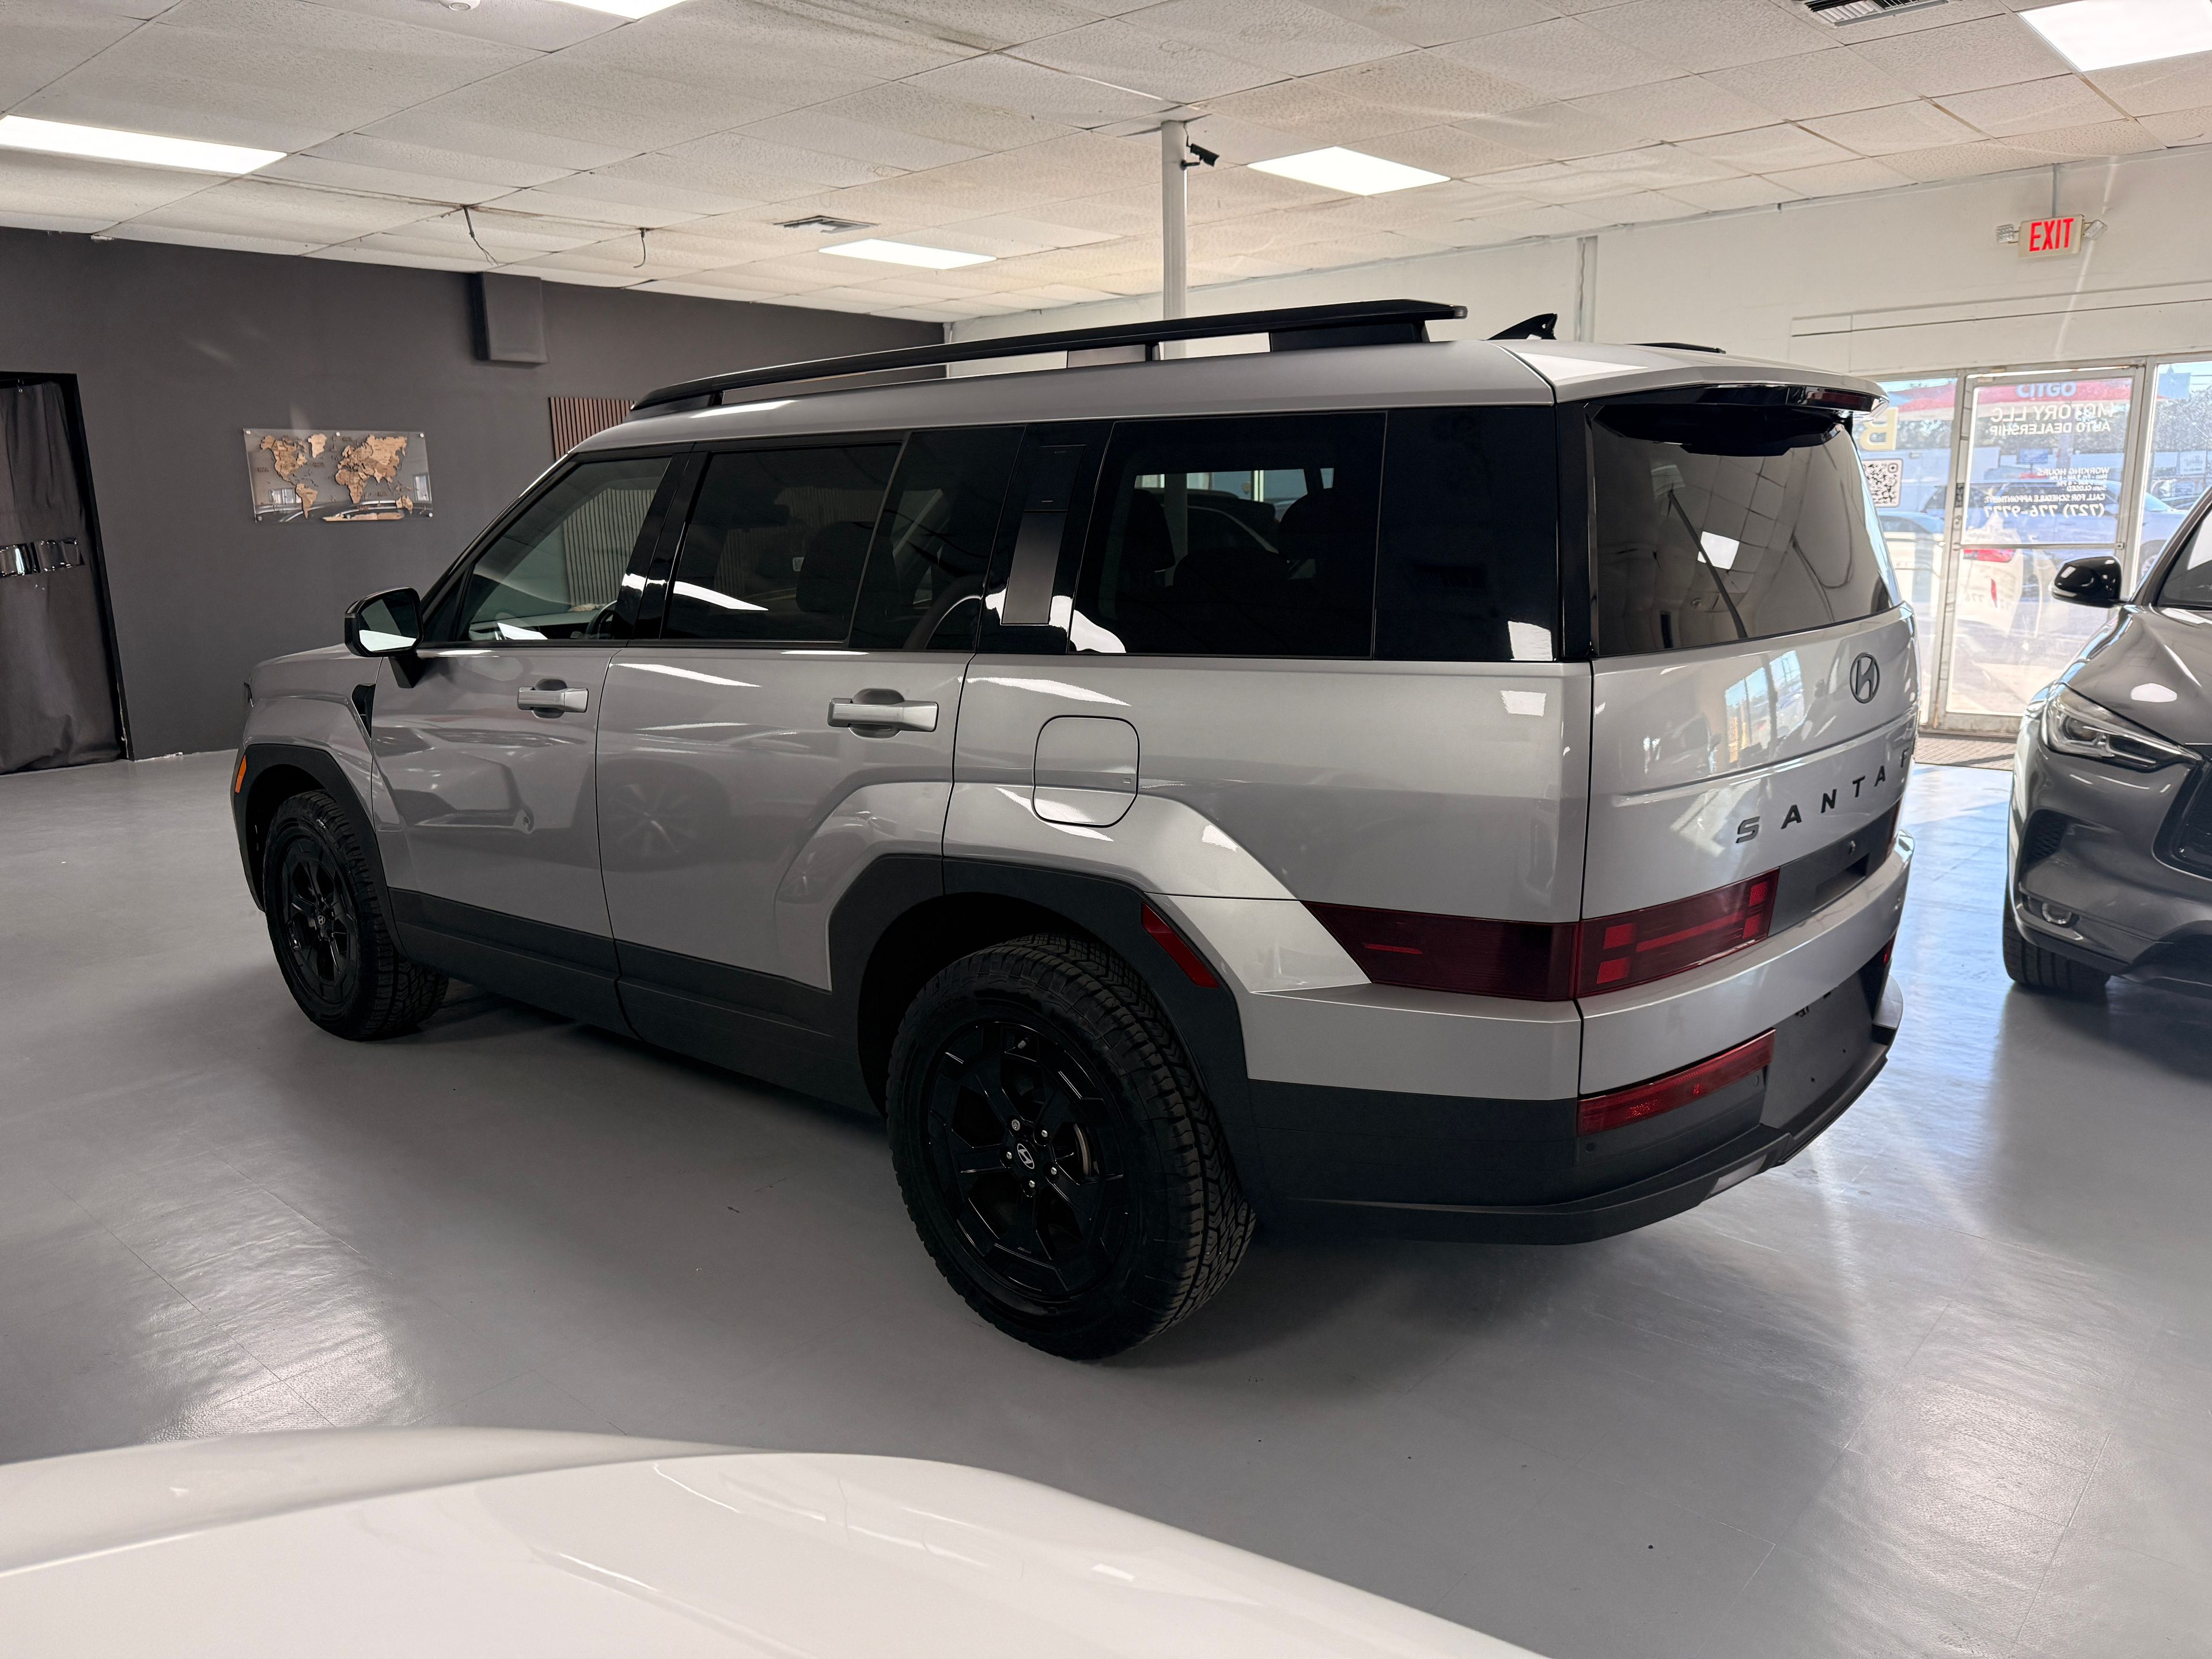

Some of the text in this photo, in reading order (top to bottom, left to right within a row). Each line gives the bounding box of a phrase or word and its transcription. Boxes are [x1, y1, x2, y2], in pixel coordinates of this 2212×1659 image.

[2029, 218, 2074, 252] EXIT
[2016, 382, 2077, 398] CITGO
[1736, 747, 1910, 844] SANTA F
